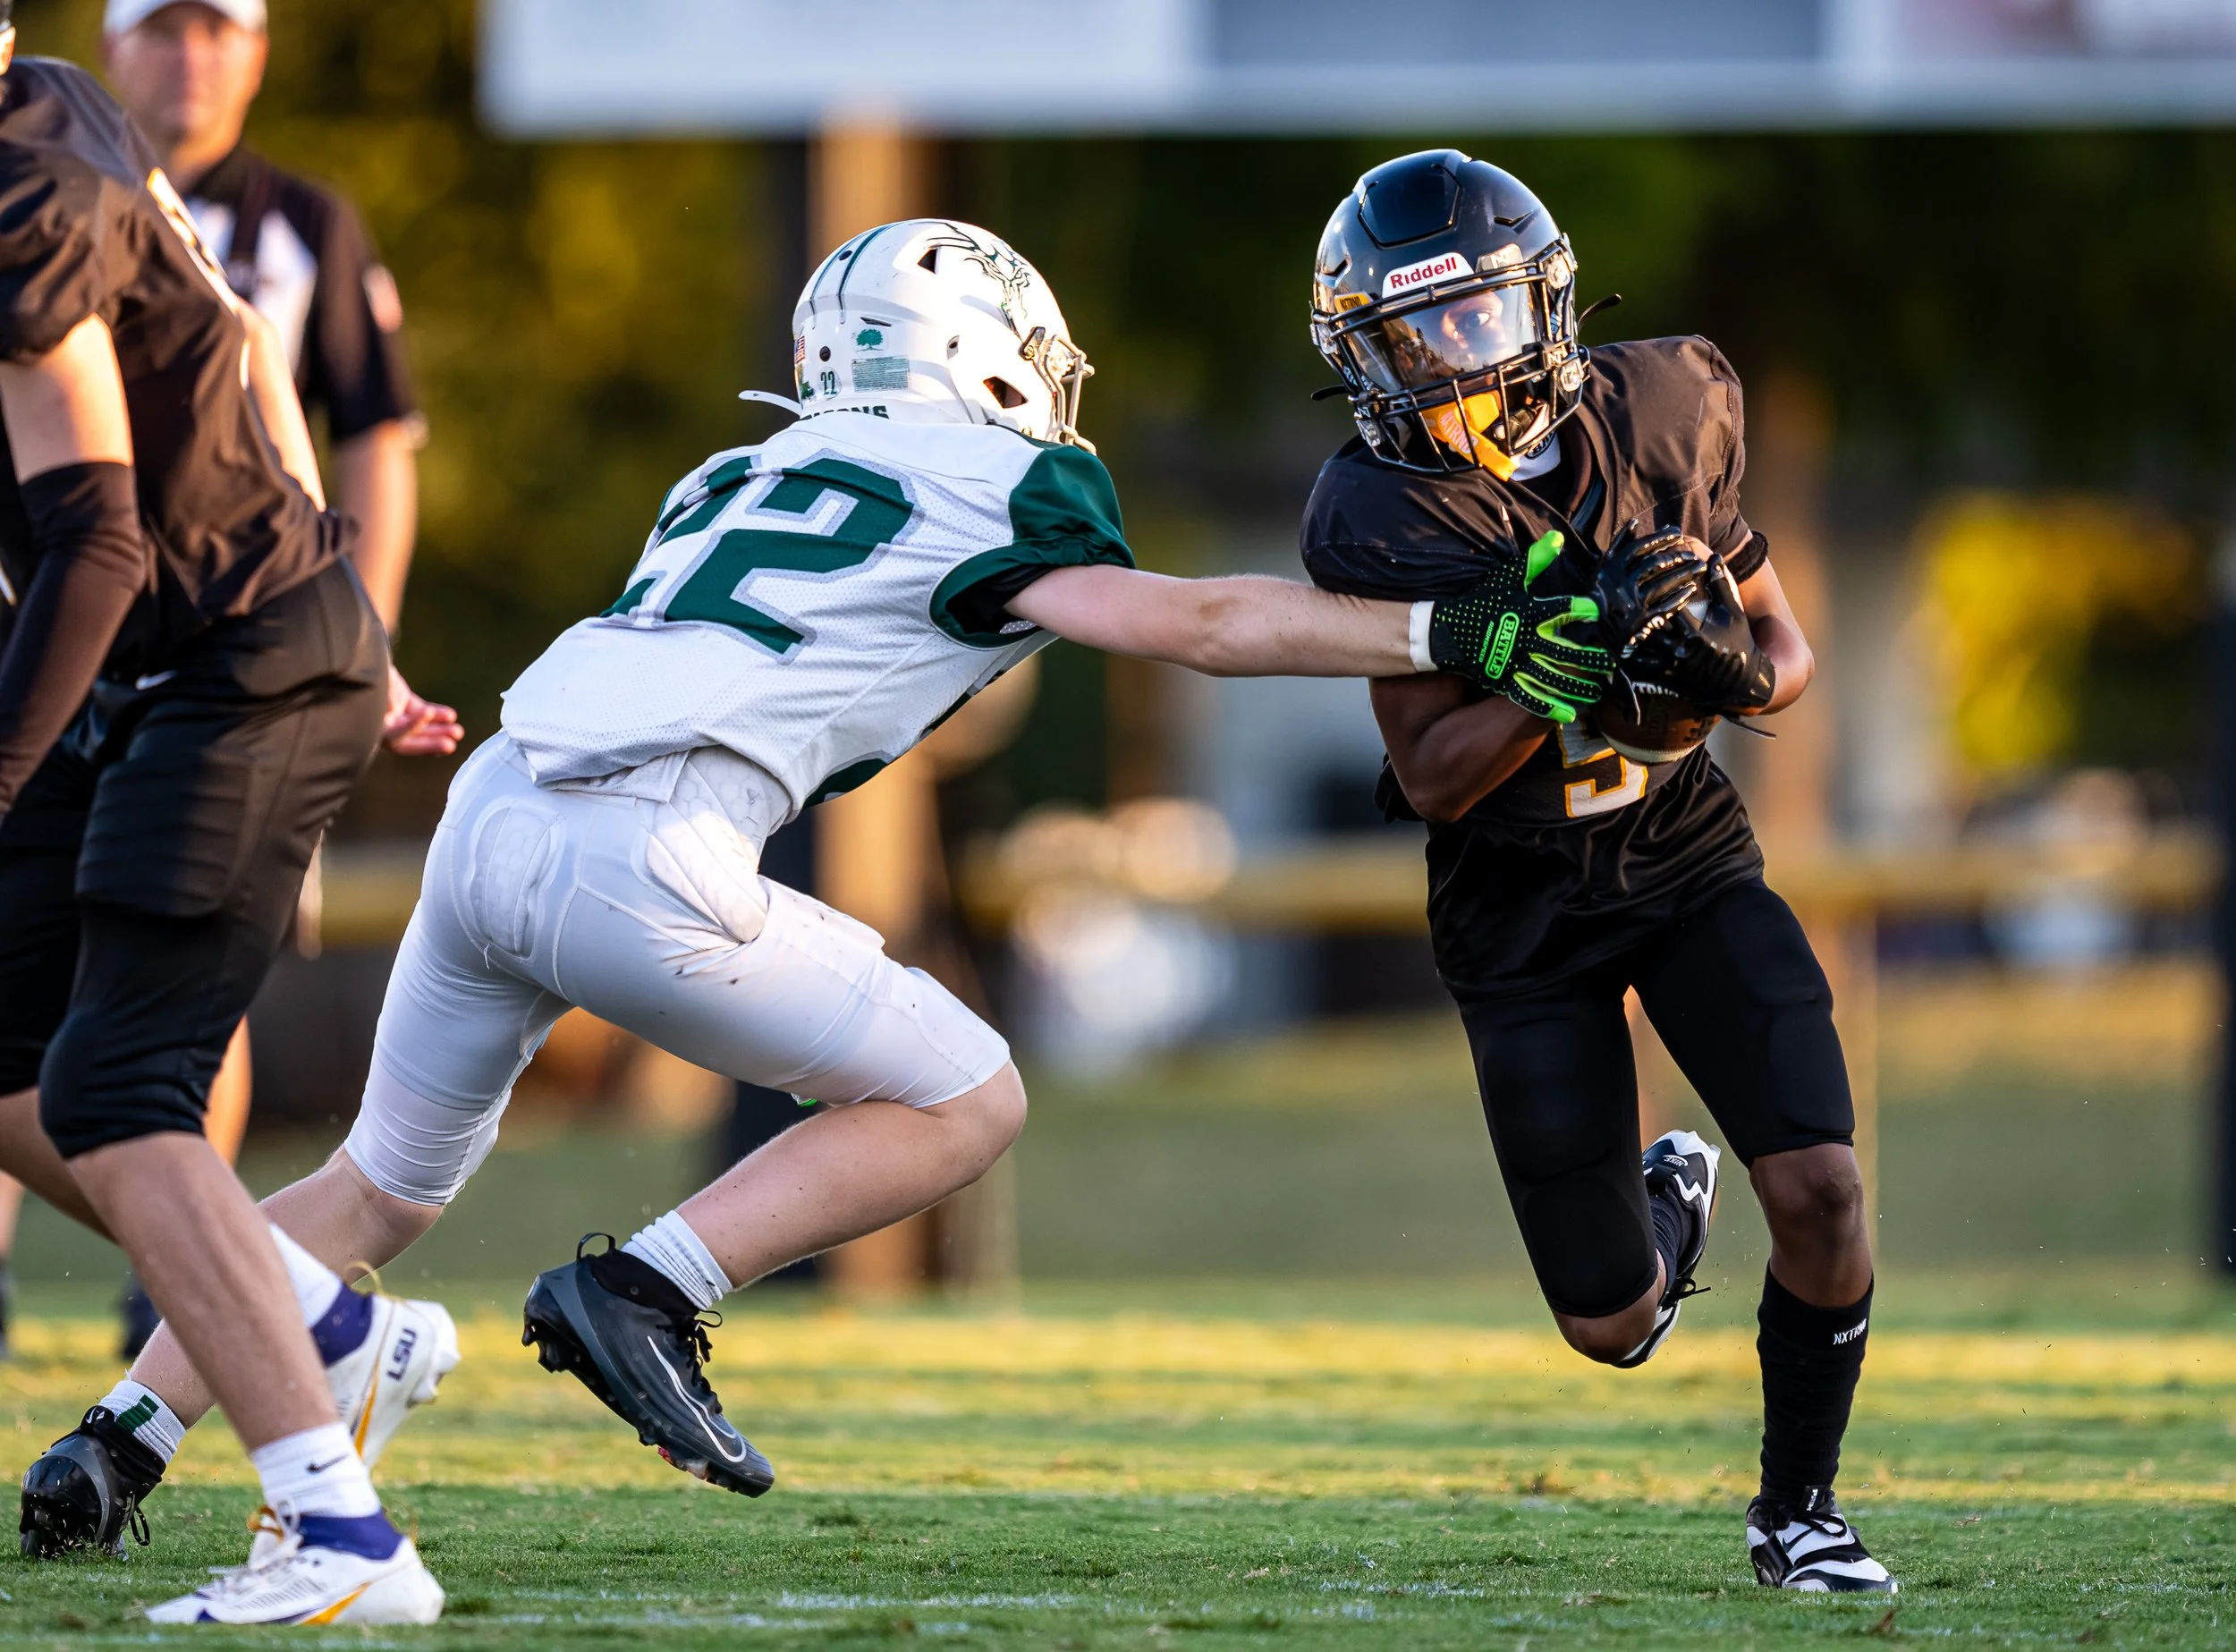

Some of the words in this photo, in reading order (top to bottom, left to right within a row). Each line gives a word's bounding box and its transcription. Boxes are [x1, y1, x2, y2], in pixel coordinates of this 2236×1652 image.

[1390, 257, 1457, 288] Riddell
[820, 370, 837, 395] 22
[599, 447, 923, 665] 22
[1489, 619, 1516, 674] BATTLE
[1664, 1156, 1684, 1166] NIKE
[386, 1328, 418, 1382] LSU
